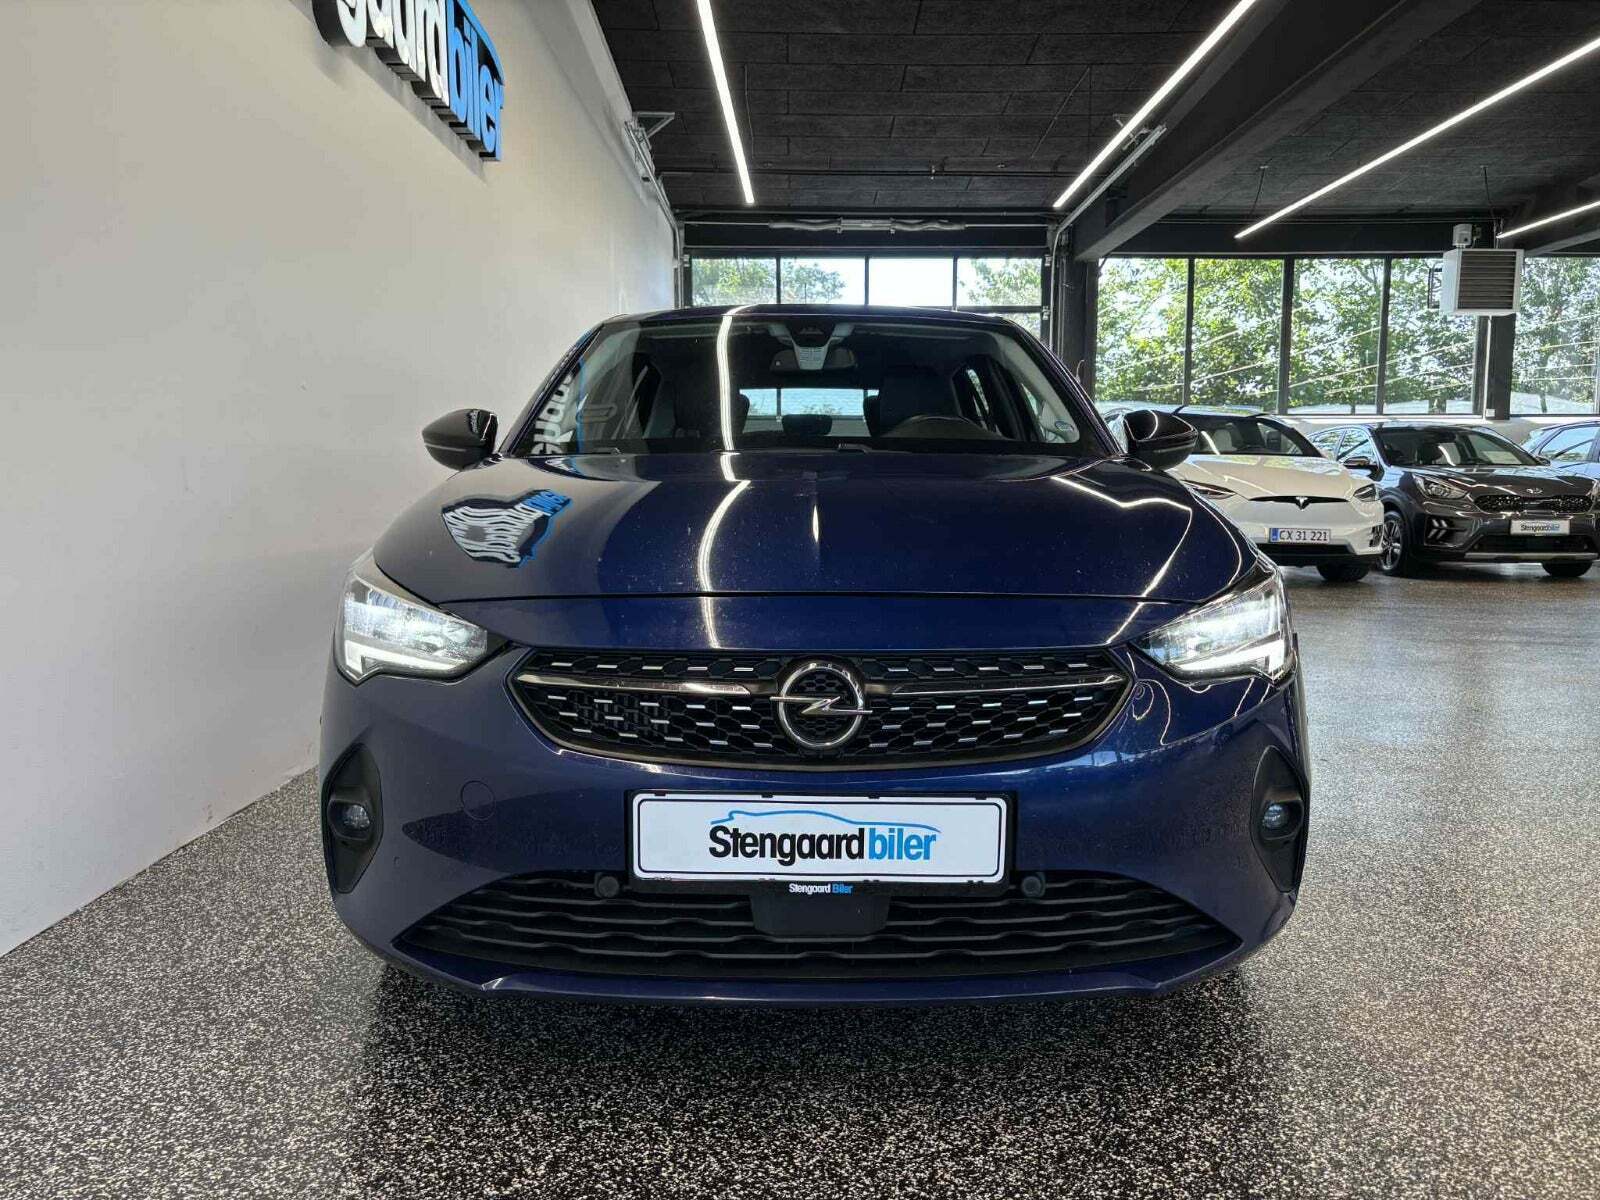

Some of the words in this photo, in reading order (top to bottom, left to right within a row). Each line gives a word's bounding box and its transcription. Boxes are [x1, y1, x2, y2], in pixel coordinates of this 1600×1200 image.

[1280, 530, 1293, 540] CX
[1296, 531, 1306, 540] 31
[1311, 531, 1328, 541] 221
[789, 883, 831, 895] Stengaard
[832, 884, 853, 893] Biler
